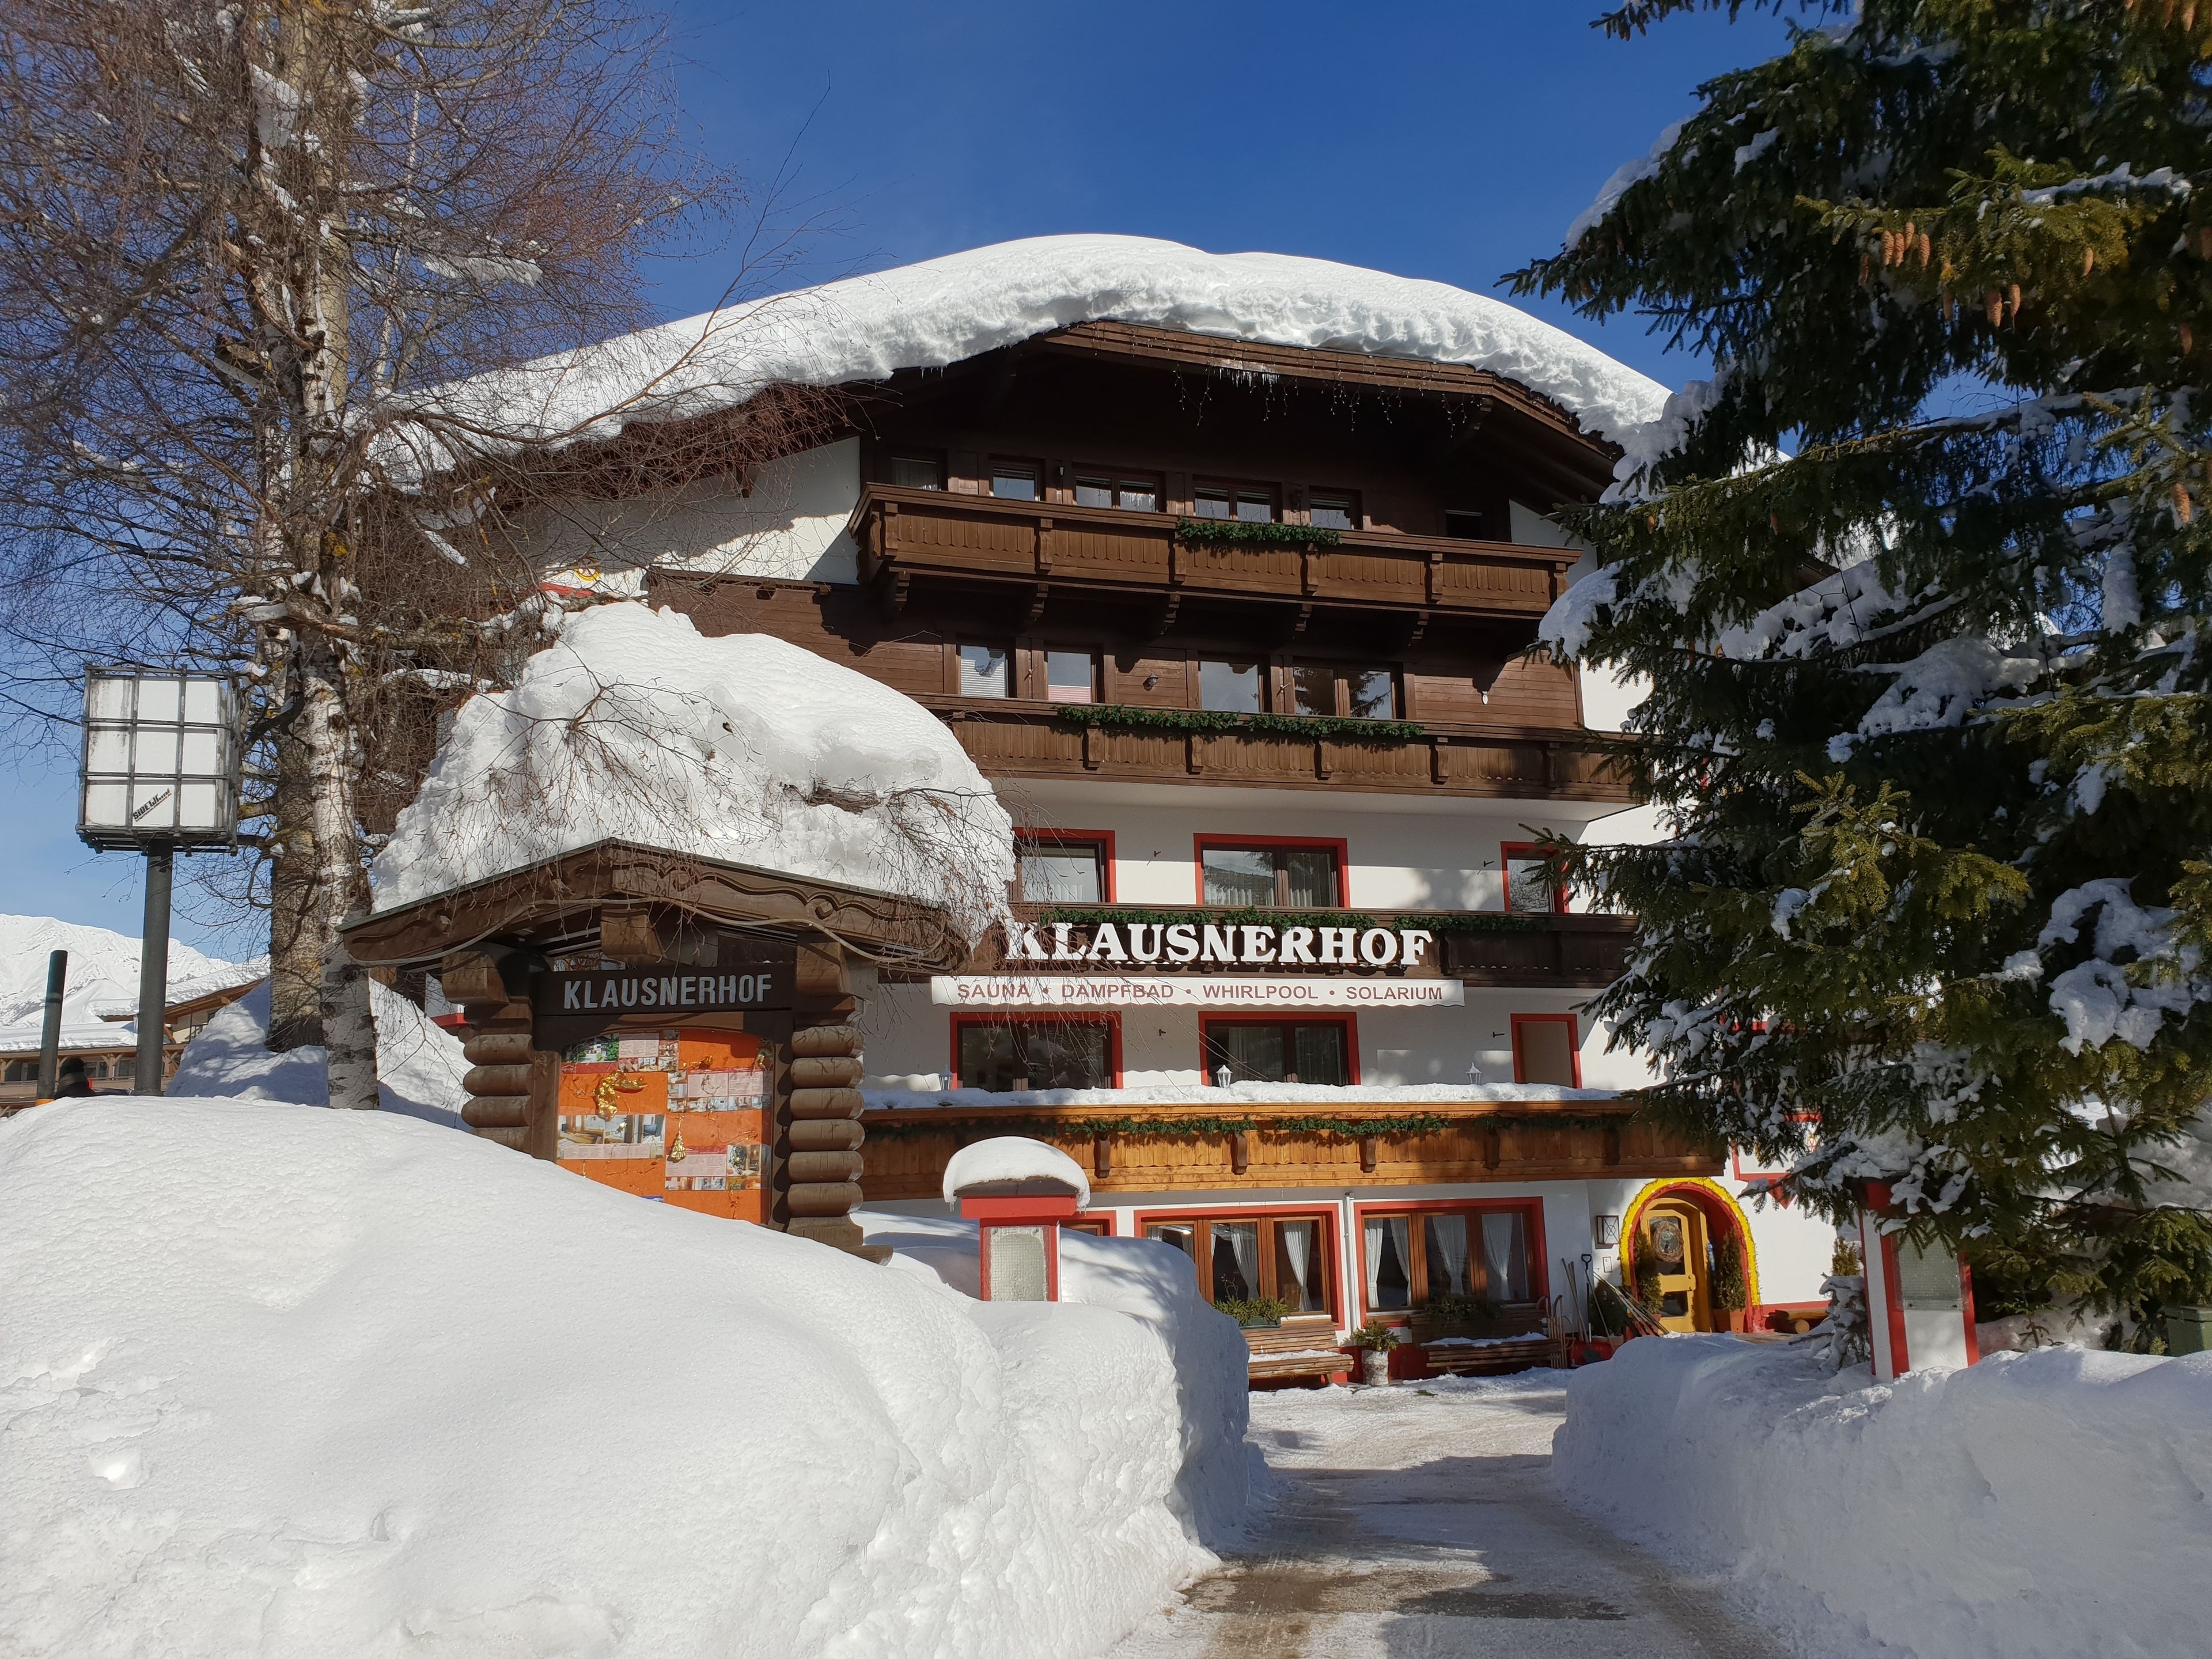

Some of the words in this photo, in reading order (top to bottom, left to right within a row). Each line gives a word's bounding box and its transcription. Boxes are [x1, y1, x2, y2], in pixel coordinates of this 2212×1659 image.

[1005, 921, 1433, 965] KLAUSNERHOF
[563, 974, 772, 1009] KLAUSNERHOF
[957, 984, 1031, 998] SAUNA
[1062, 984, 1173, 998] DAMPFBAD
[1202, 985, 1319, 999] WHIRLPOOL
[1346, 986, 1442, 1000] SOLARIUM
